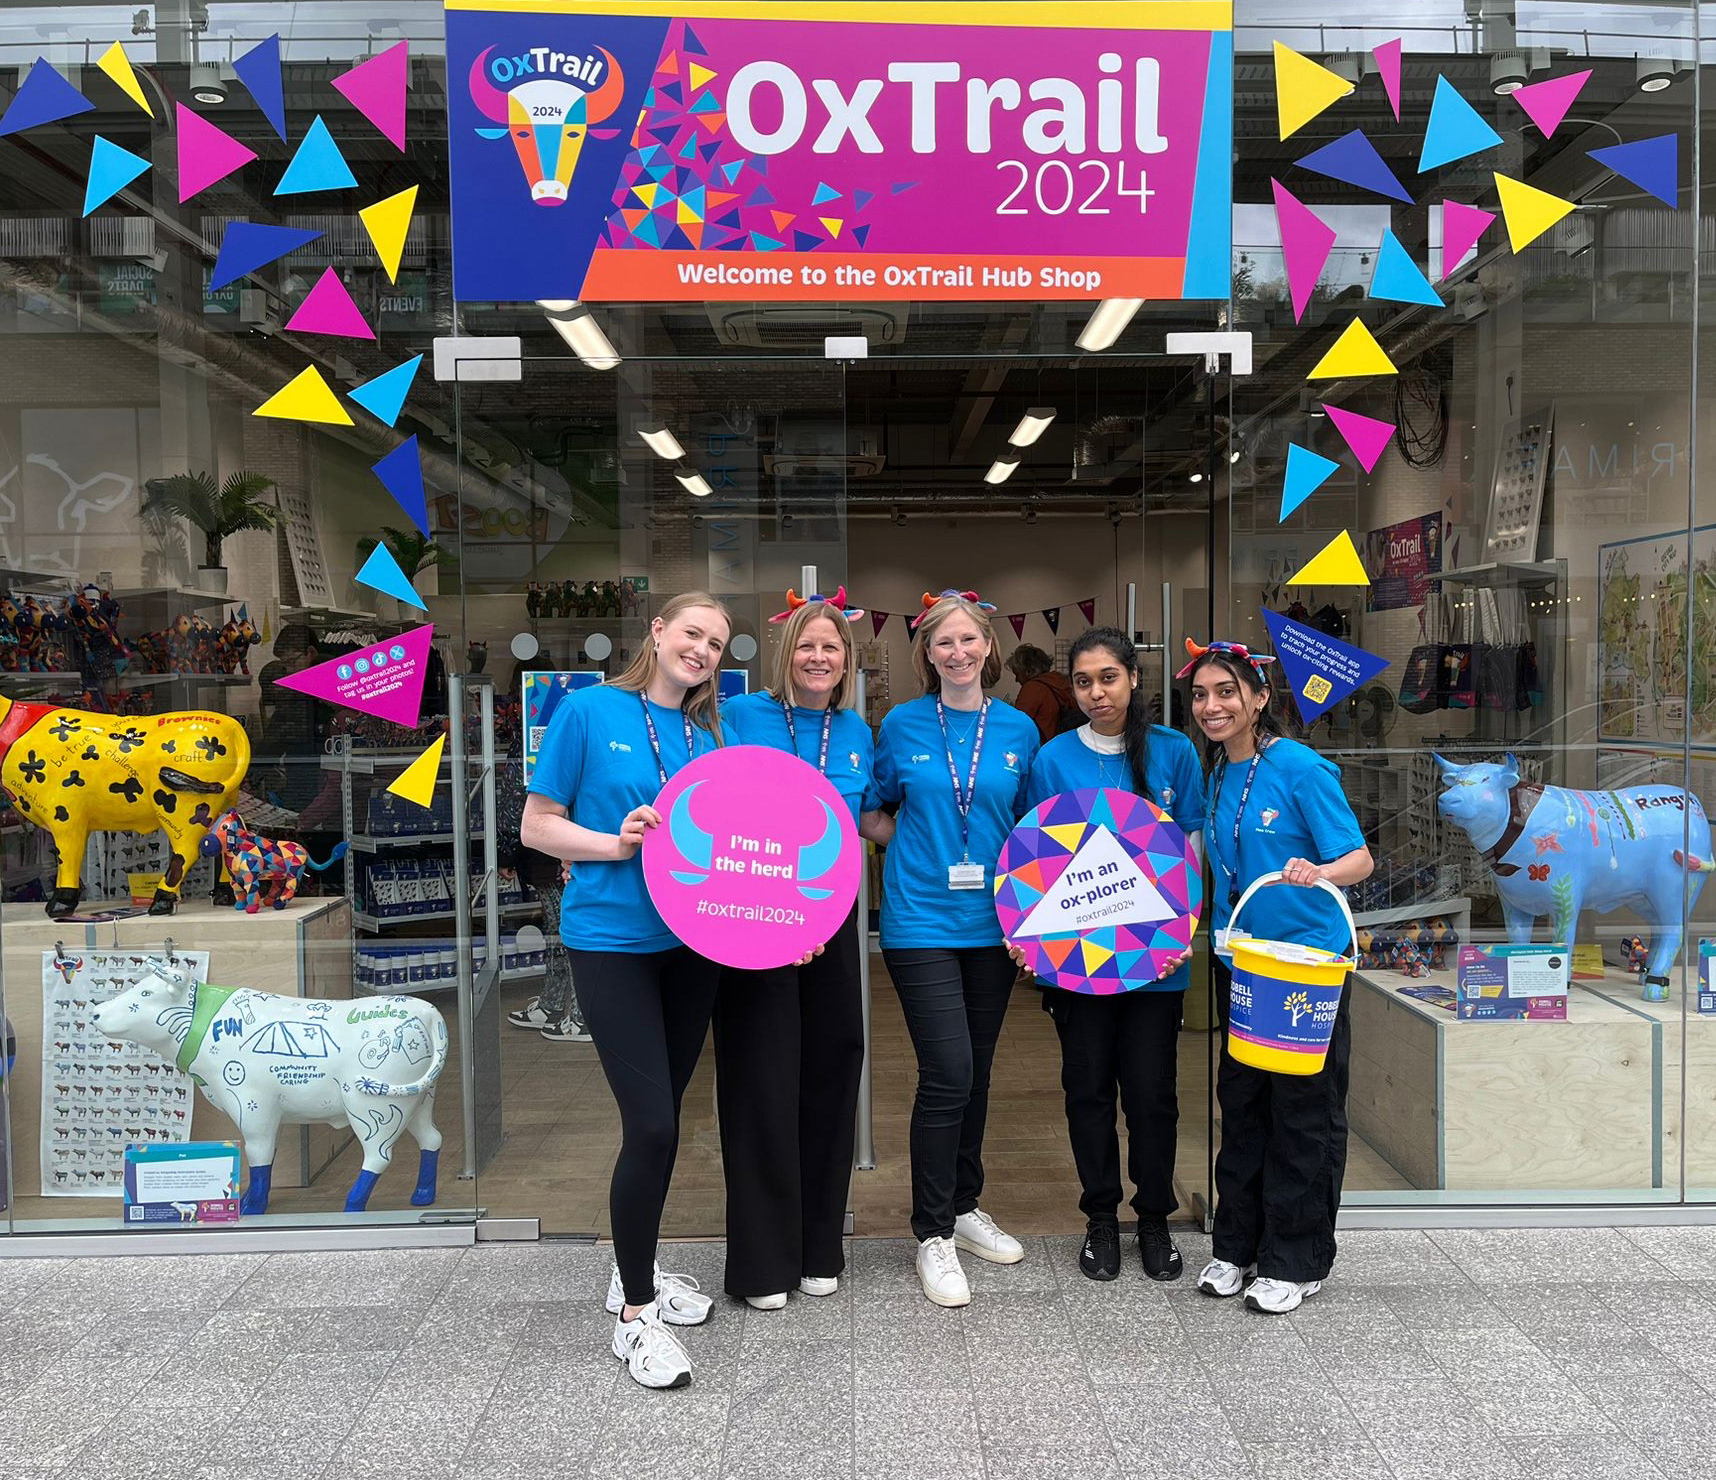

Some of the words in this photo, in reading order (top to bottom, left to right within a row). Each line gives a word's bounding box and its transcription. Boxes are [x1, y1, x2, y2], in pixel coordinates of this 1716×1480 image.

[491, 47, 604, 86] OxTrail
[532, 106, 562, 117] 2024
[725, 52, 1169, 156] OxTrail
[996, 160, 1156, 215] 2024
[677, 264, 793, 287] Welcome
[801, 267, 826, 288] to
[834, 265, 876, 288] the
[884, 265, 973, 289] OxTrail
[982, 266, 1032, 289] Hub
[1040, 266, 1101, 291] Shop
[1390, 534, 1421, 559] OxTrail
[1284, 624, 1316, 645] Download
[1315, 641, 1327, 651] the
[1327, 648, 1348, 662] OxTrail
[1348, 659, 1360, 669] app
[1288, 636, 1305, 649] track
[1305, 645, 1320, 656] your
[1320, 653, 1347, 671] progress
[1347, 668, 1360, 678] and
[337, 680, 358, 692] Follow
[360, 666, 402, 684] @oxtrail2024
[402, 659, 416, 669] and
[1281, 642, 1304, 656] unlock
[1302, 653, 1329, 671] ox-citing
[1329, 667, 1356, 686] rewards.
[344, 690, 356, 699] tag
[356, 686, 365, 694] us
[374, 678, 388, 688] your
[390, 668, 415, 682] photos!
[361, 681, 403, 700] #oxtrail2024
[158, 715, 221, 727] Brownies
[50, 754, 67, 768] be
[67, 735, 91, 755] true
[105, 748, 139, 777] challenge
[174, 751, 203, 763] craft
[10, 778, 48, 813] adventure
[730, 834, 759, 852] I'm
[764, 838, 782, 855] in
[715, 856, 746, 873] the
[751, 860, 793, 879] herd
[1066, 869, 1094, 886] I'm
[1098, 861, 1119, 876] an
[1060, 876, 1137, 910] ox-plorer
[696, 899, 805, 925] #oxtrail2024
[1076, 900, 1135, 924] #oxtrail2024
[346, 1005, 408, 1024] Guides
[212, 1017, 243, 1042] FUN
[269, 1065, 318, 1073] COMMUNITY
[277, 1072, 326, 1080] FRIENDSHIP
[280, 1078, 310, 1086] CARING
